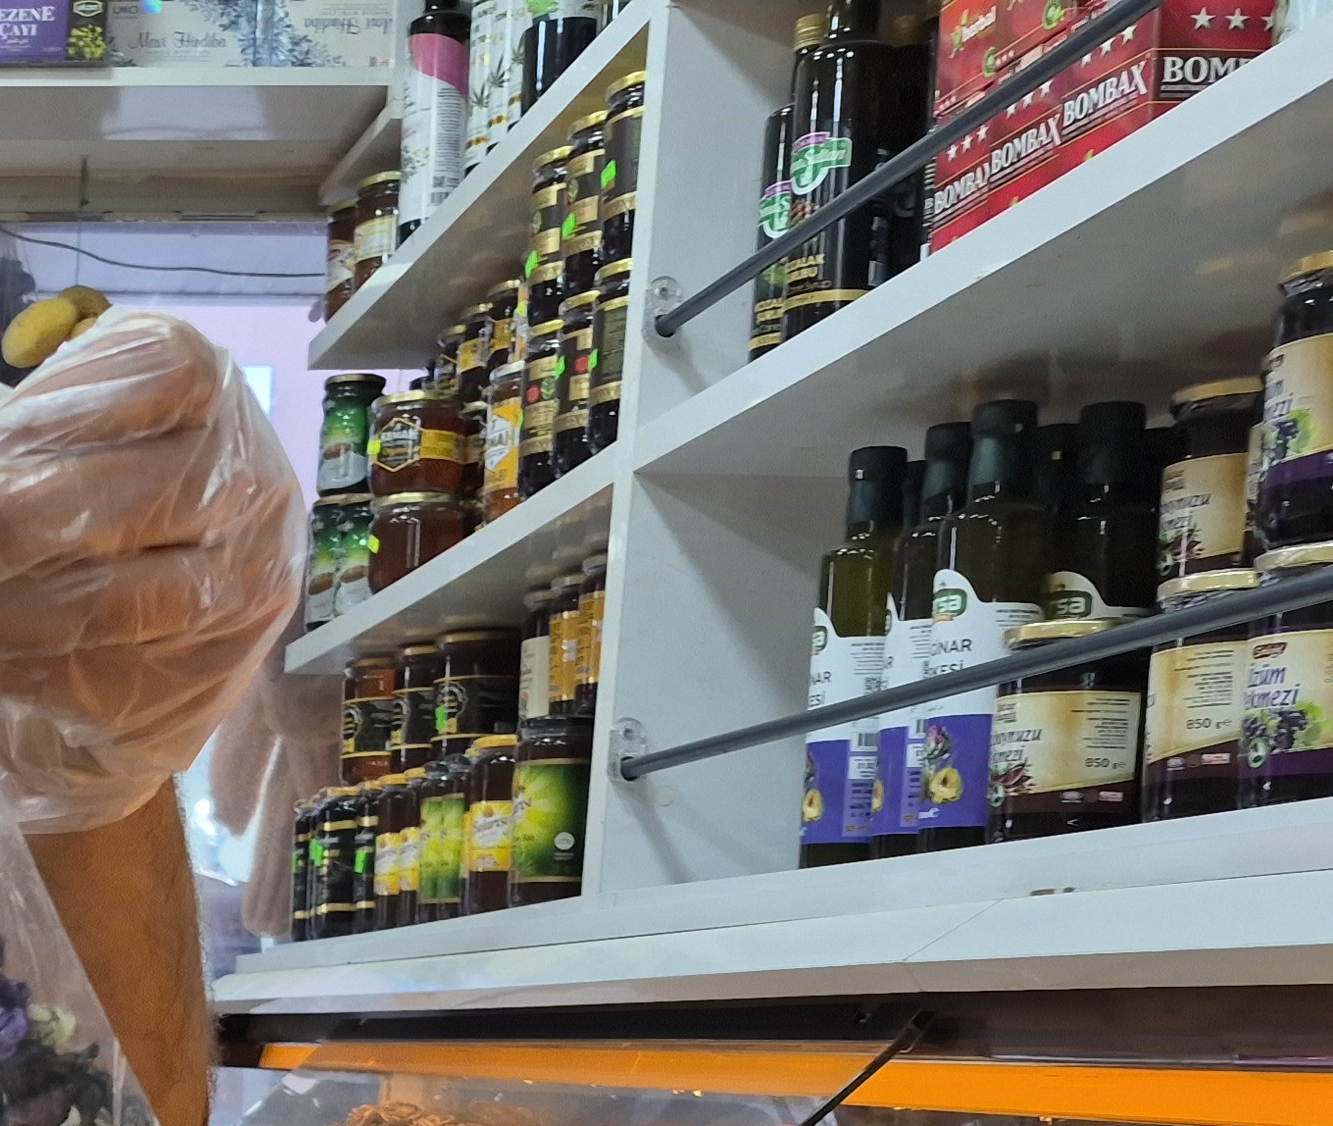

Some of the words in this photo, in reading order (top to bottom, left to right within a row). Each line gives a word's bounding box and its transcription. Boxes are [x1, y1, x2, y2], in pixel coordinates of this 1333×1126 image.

[1062, 61, 1148, 128] BOMBAX
[990, 114, 1063, 176] BOMBAX
[1186, 717, 1212, 730] 850
[1084, 756, 1110, 769] 850
